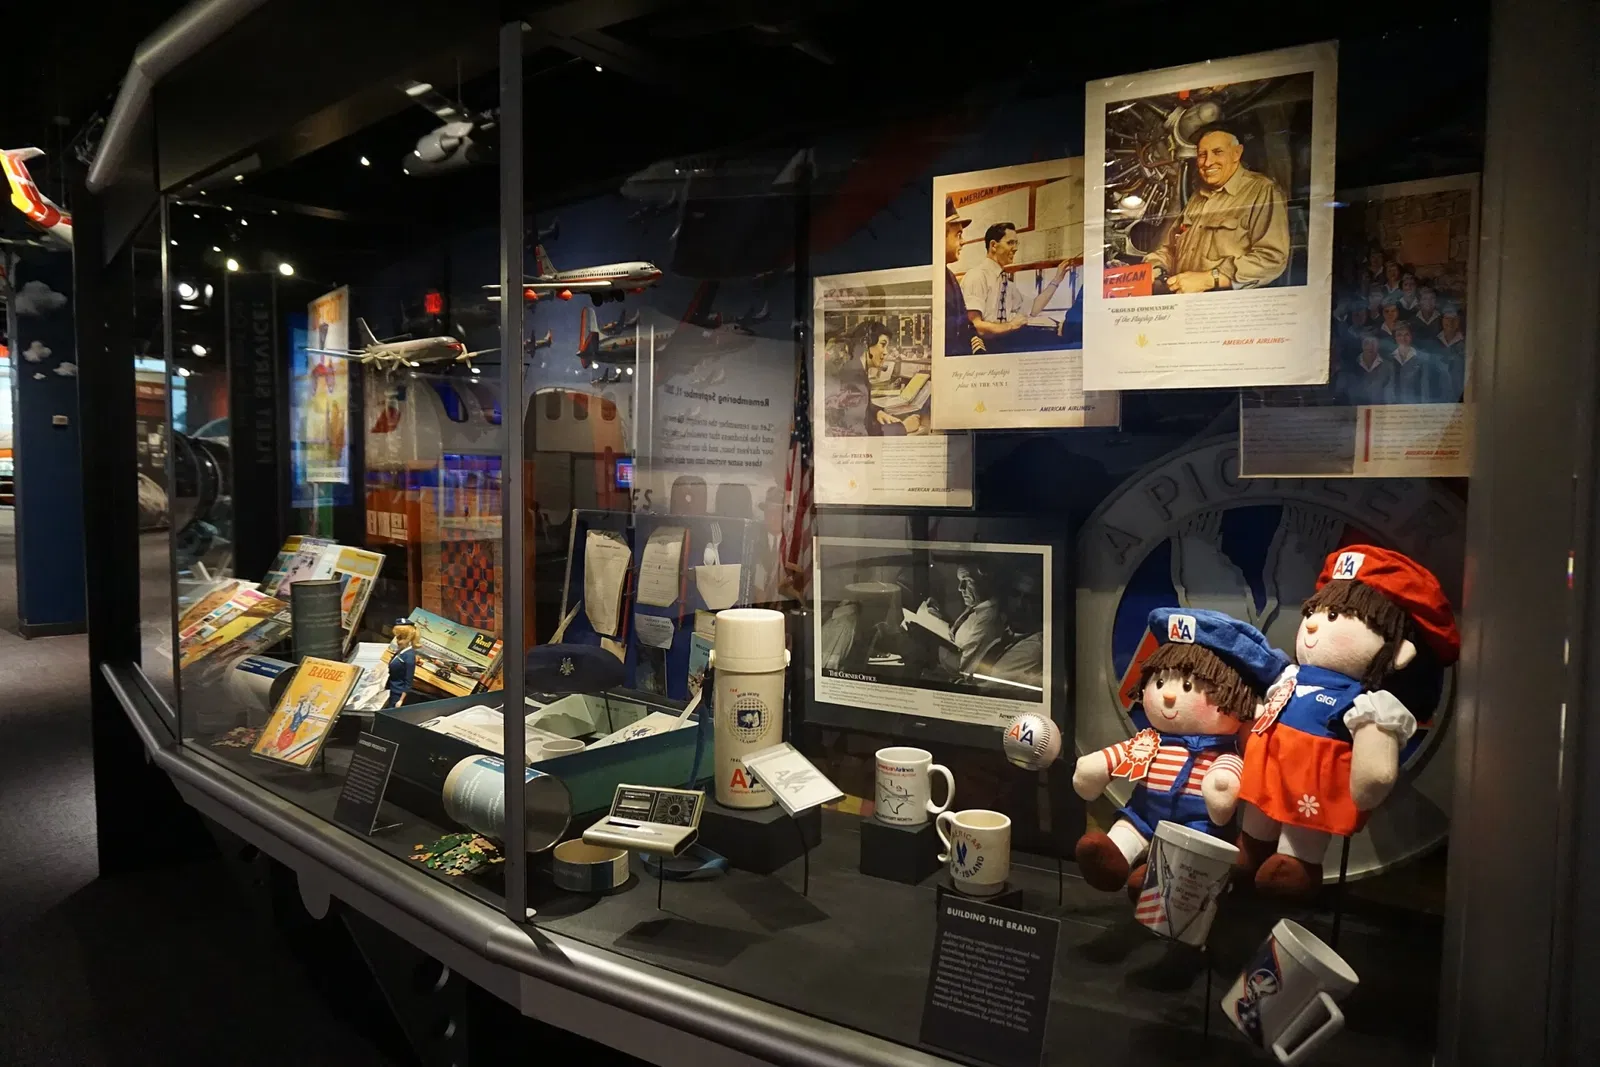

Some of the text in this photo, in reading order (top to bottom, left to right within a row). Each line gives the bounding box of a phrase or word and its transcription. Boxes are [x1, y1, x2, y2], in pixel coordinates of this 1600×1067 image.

[959, 188, 994, 204] AMERICAN
[1222, 338, 1254, 346] AMERICAN
[1104, 521, 1142, 565] A
[1170, 622, 1192, 640] AA
[307, 666, 346, 682] BARBIE
[839, 671, 858, 680] CORNER
[1315, 694, 1337, 707] GIGI
[947, 907, 1037, 935] BUILDING THE BRAND
